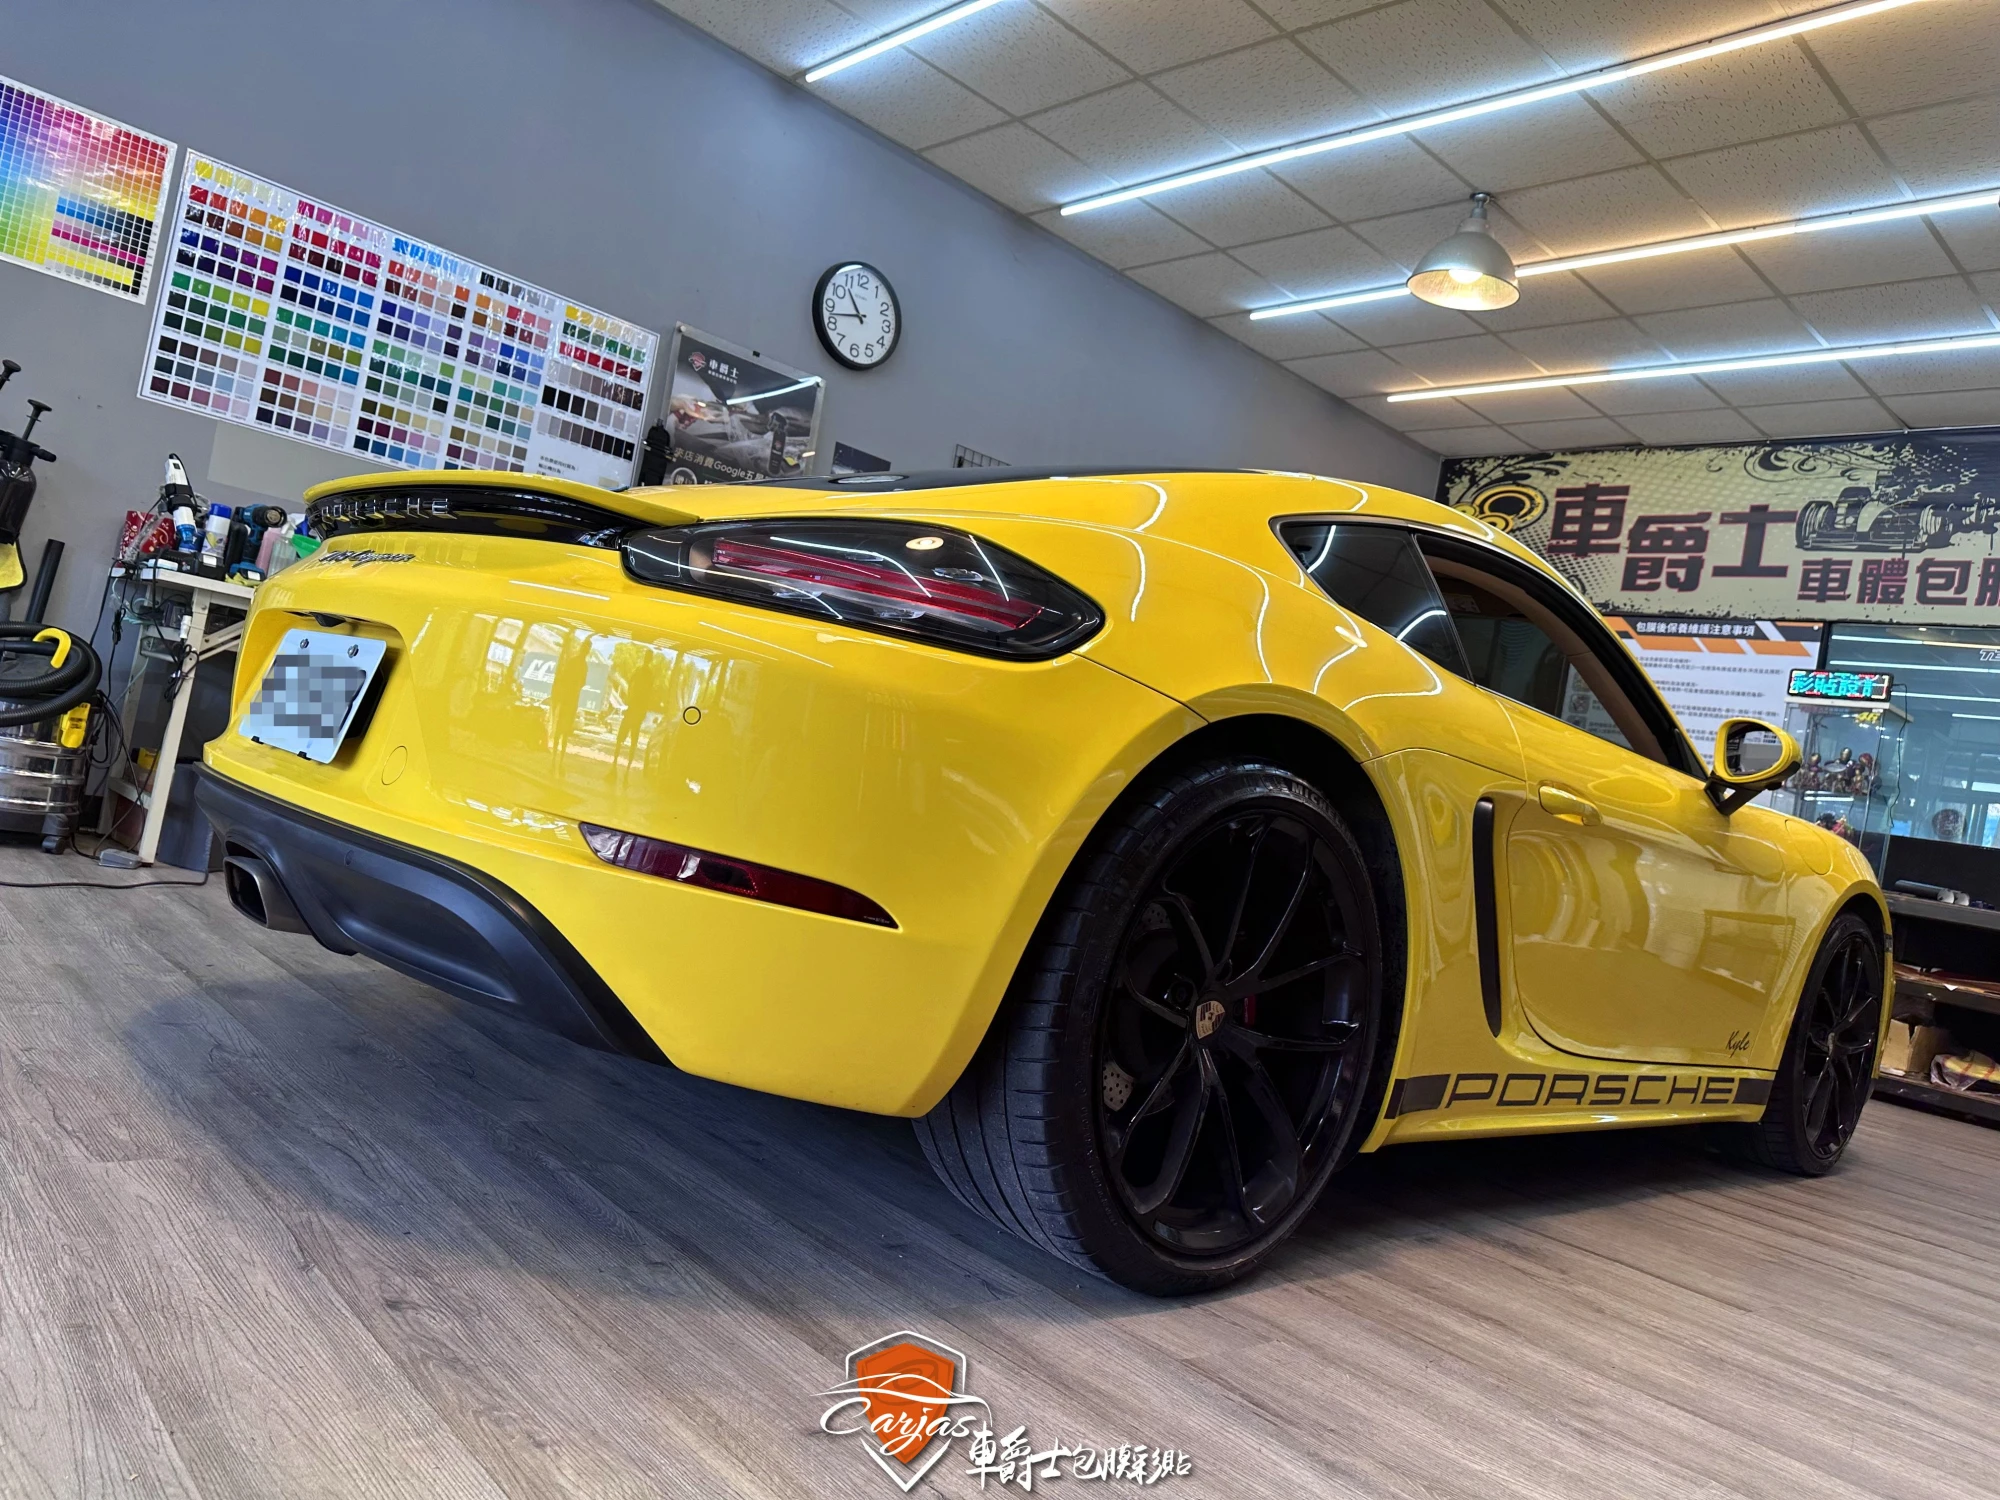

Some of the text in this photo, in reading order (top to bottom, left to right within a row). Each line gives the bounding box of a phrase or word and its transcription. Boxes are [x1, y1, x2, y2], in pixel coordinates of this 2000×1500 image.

[845, 274, 854, 289] 11
[857, 273, 870, 290] 12
[832, 283, 846, 299] 10
[875, 286, 879, 299] 1
[825, 298, 835, 313] 9
[880, 302, 890, 317] 2
[827, 316, 837, 331] 8
[881, 320, 891, 334] 3
[836, 332, 846, 347] 7
[876, 335, 886, 349] 4
[849, 343, 860, 358] 6
[864, 343, 874, 358] 5
[1547, 483, 1798, 592] 車爵士
[1636, 621, 1755, 637] 包膜後保養維護注意事項
[1725, 1031, 1750, 1058] Kyle
[1444, 1073, 1736, 1109] PORSCHE
